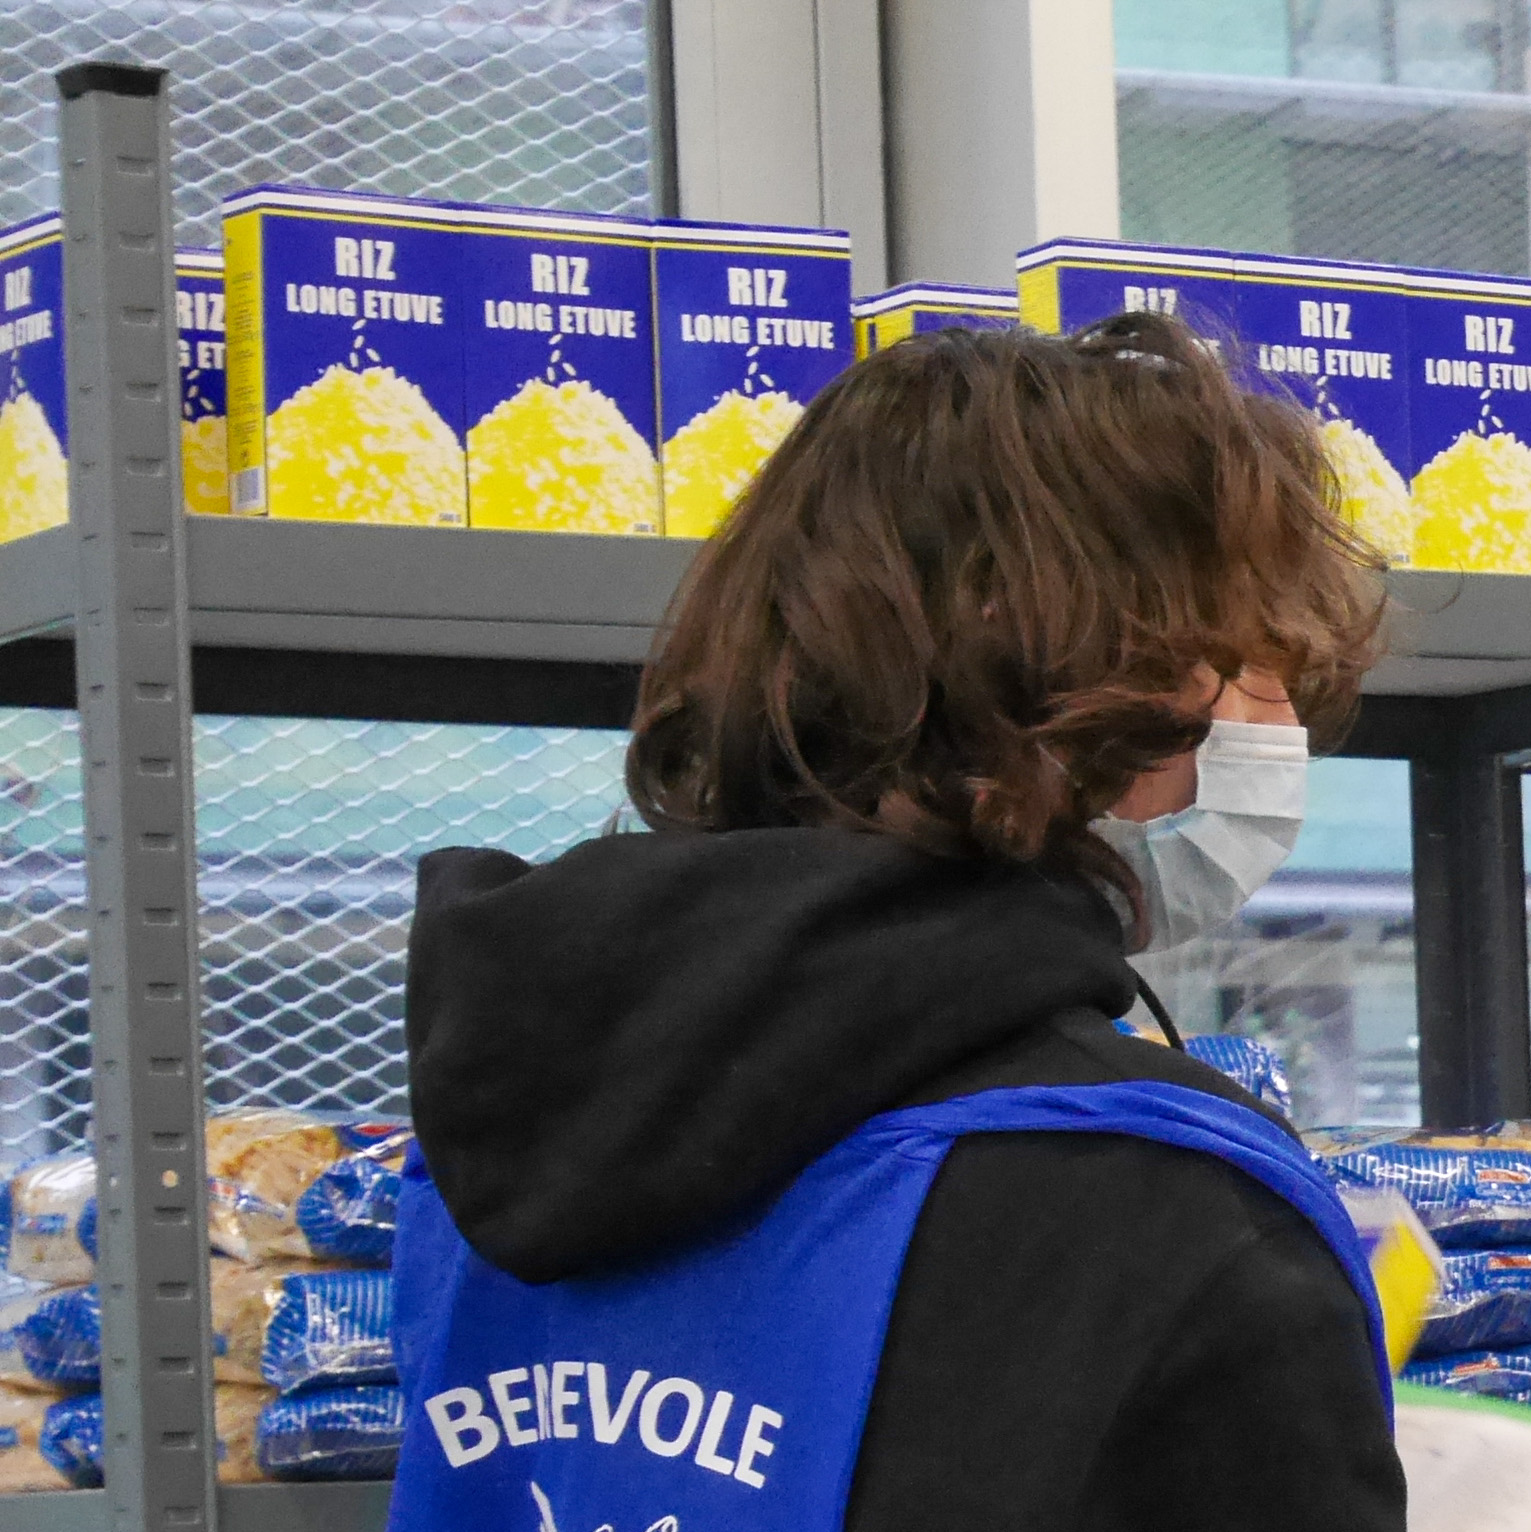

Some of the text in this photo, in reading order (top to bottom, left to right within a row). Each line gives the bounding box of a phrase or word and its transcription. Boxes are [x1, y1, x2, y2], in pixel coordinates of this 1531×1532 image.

[335, 236, 396, 281] RIZ
[531, 253, 590, 296] RIZ
[286, 283, 444, 326] LONG ETUVE
[728, 267, 788, 308] RIZ
[485, 300, 636, 339] LONG ETUVE
[681, 314, 834, 350] LONG ETUVE
[1300, 301, 1352, 340] RIZ
[1464, 315, 1515, 354] RIZ
[1259, 344, 1319, 375] LONG
[1325, 348, 1393, 380] ETUVE
[1425, 358, 1483, 388] LONG
